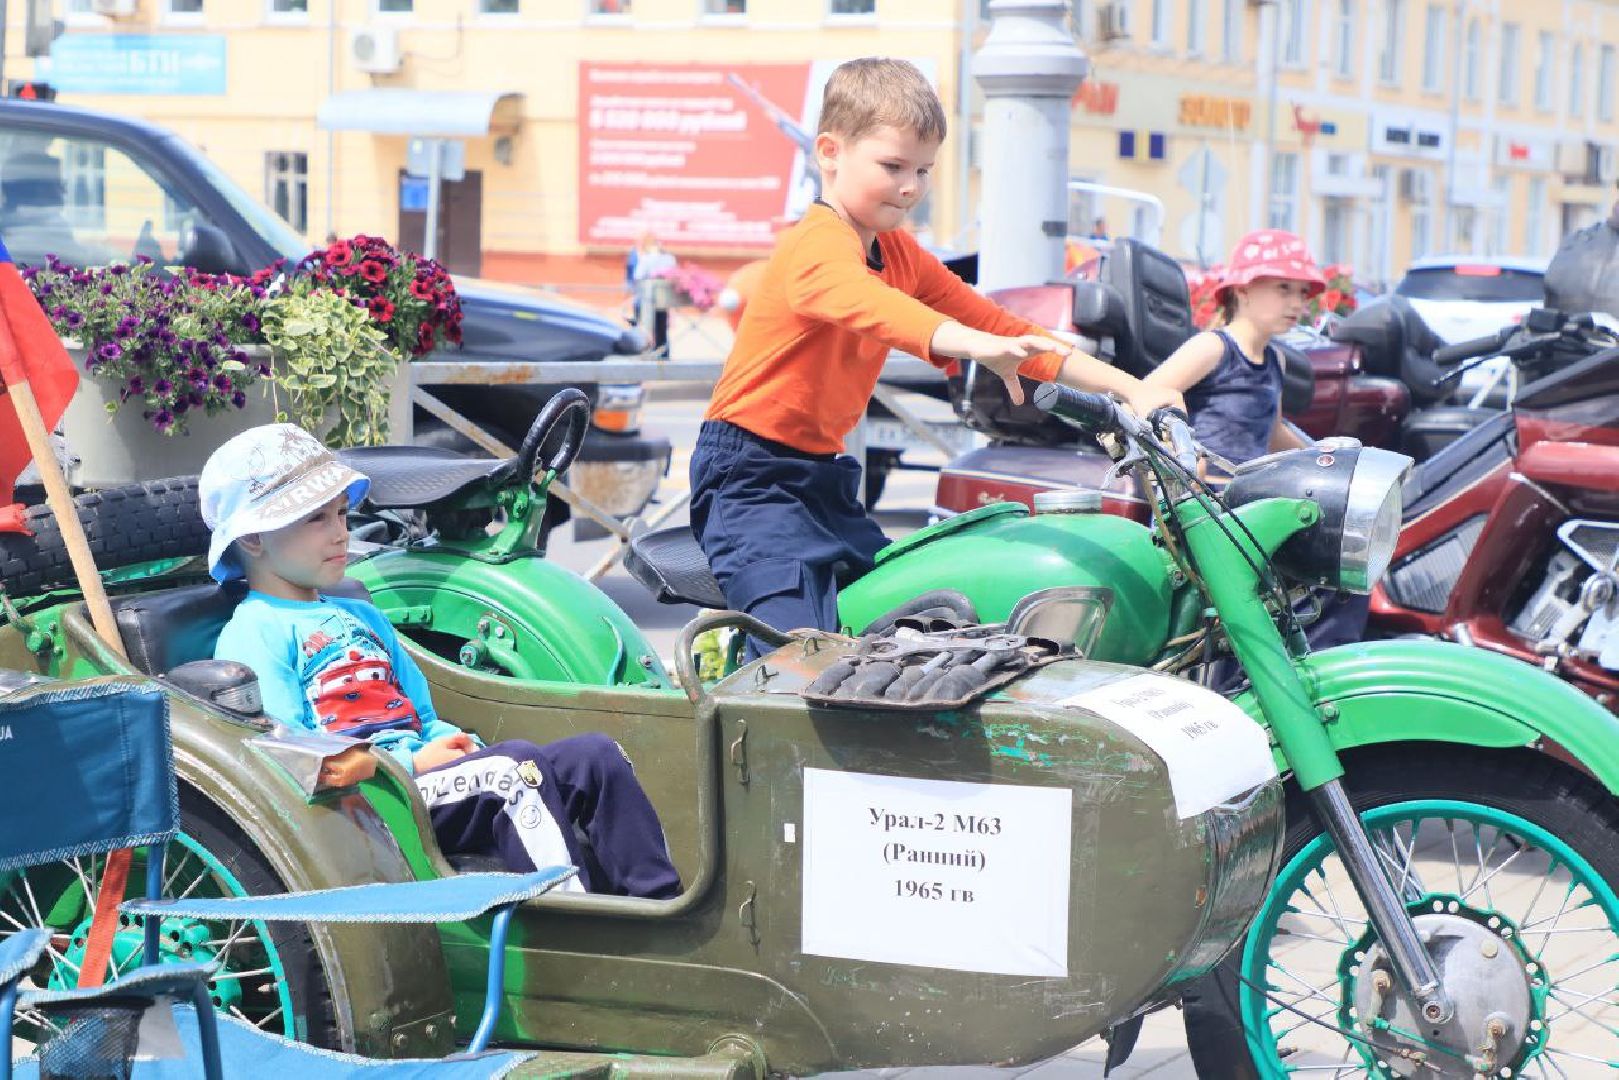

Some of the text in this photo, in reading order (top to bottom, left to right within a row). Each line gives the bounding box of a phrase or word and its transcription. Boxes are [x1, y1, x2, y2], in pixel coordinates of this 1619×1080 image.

[869, 807, 1002, 836] Урал-2 М63
[883, 843, 986, 872] (Ранний)
[895, 880, 974, 902] 1965 гв
